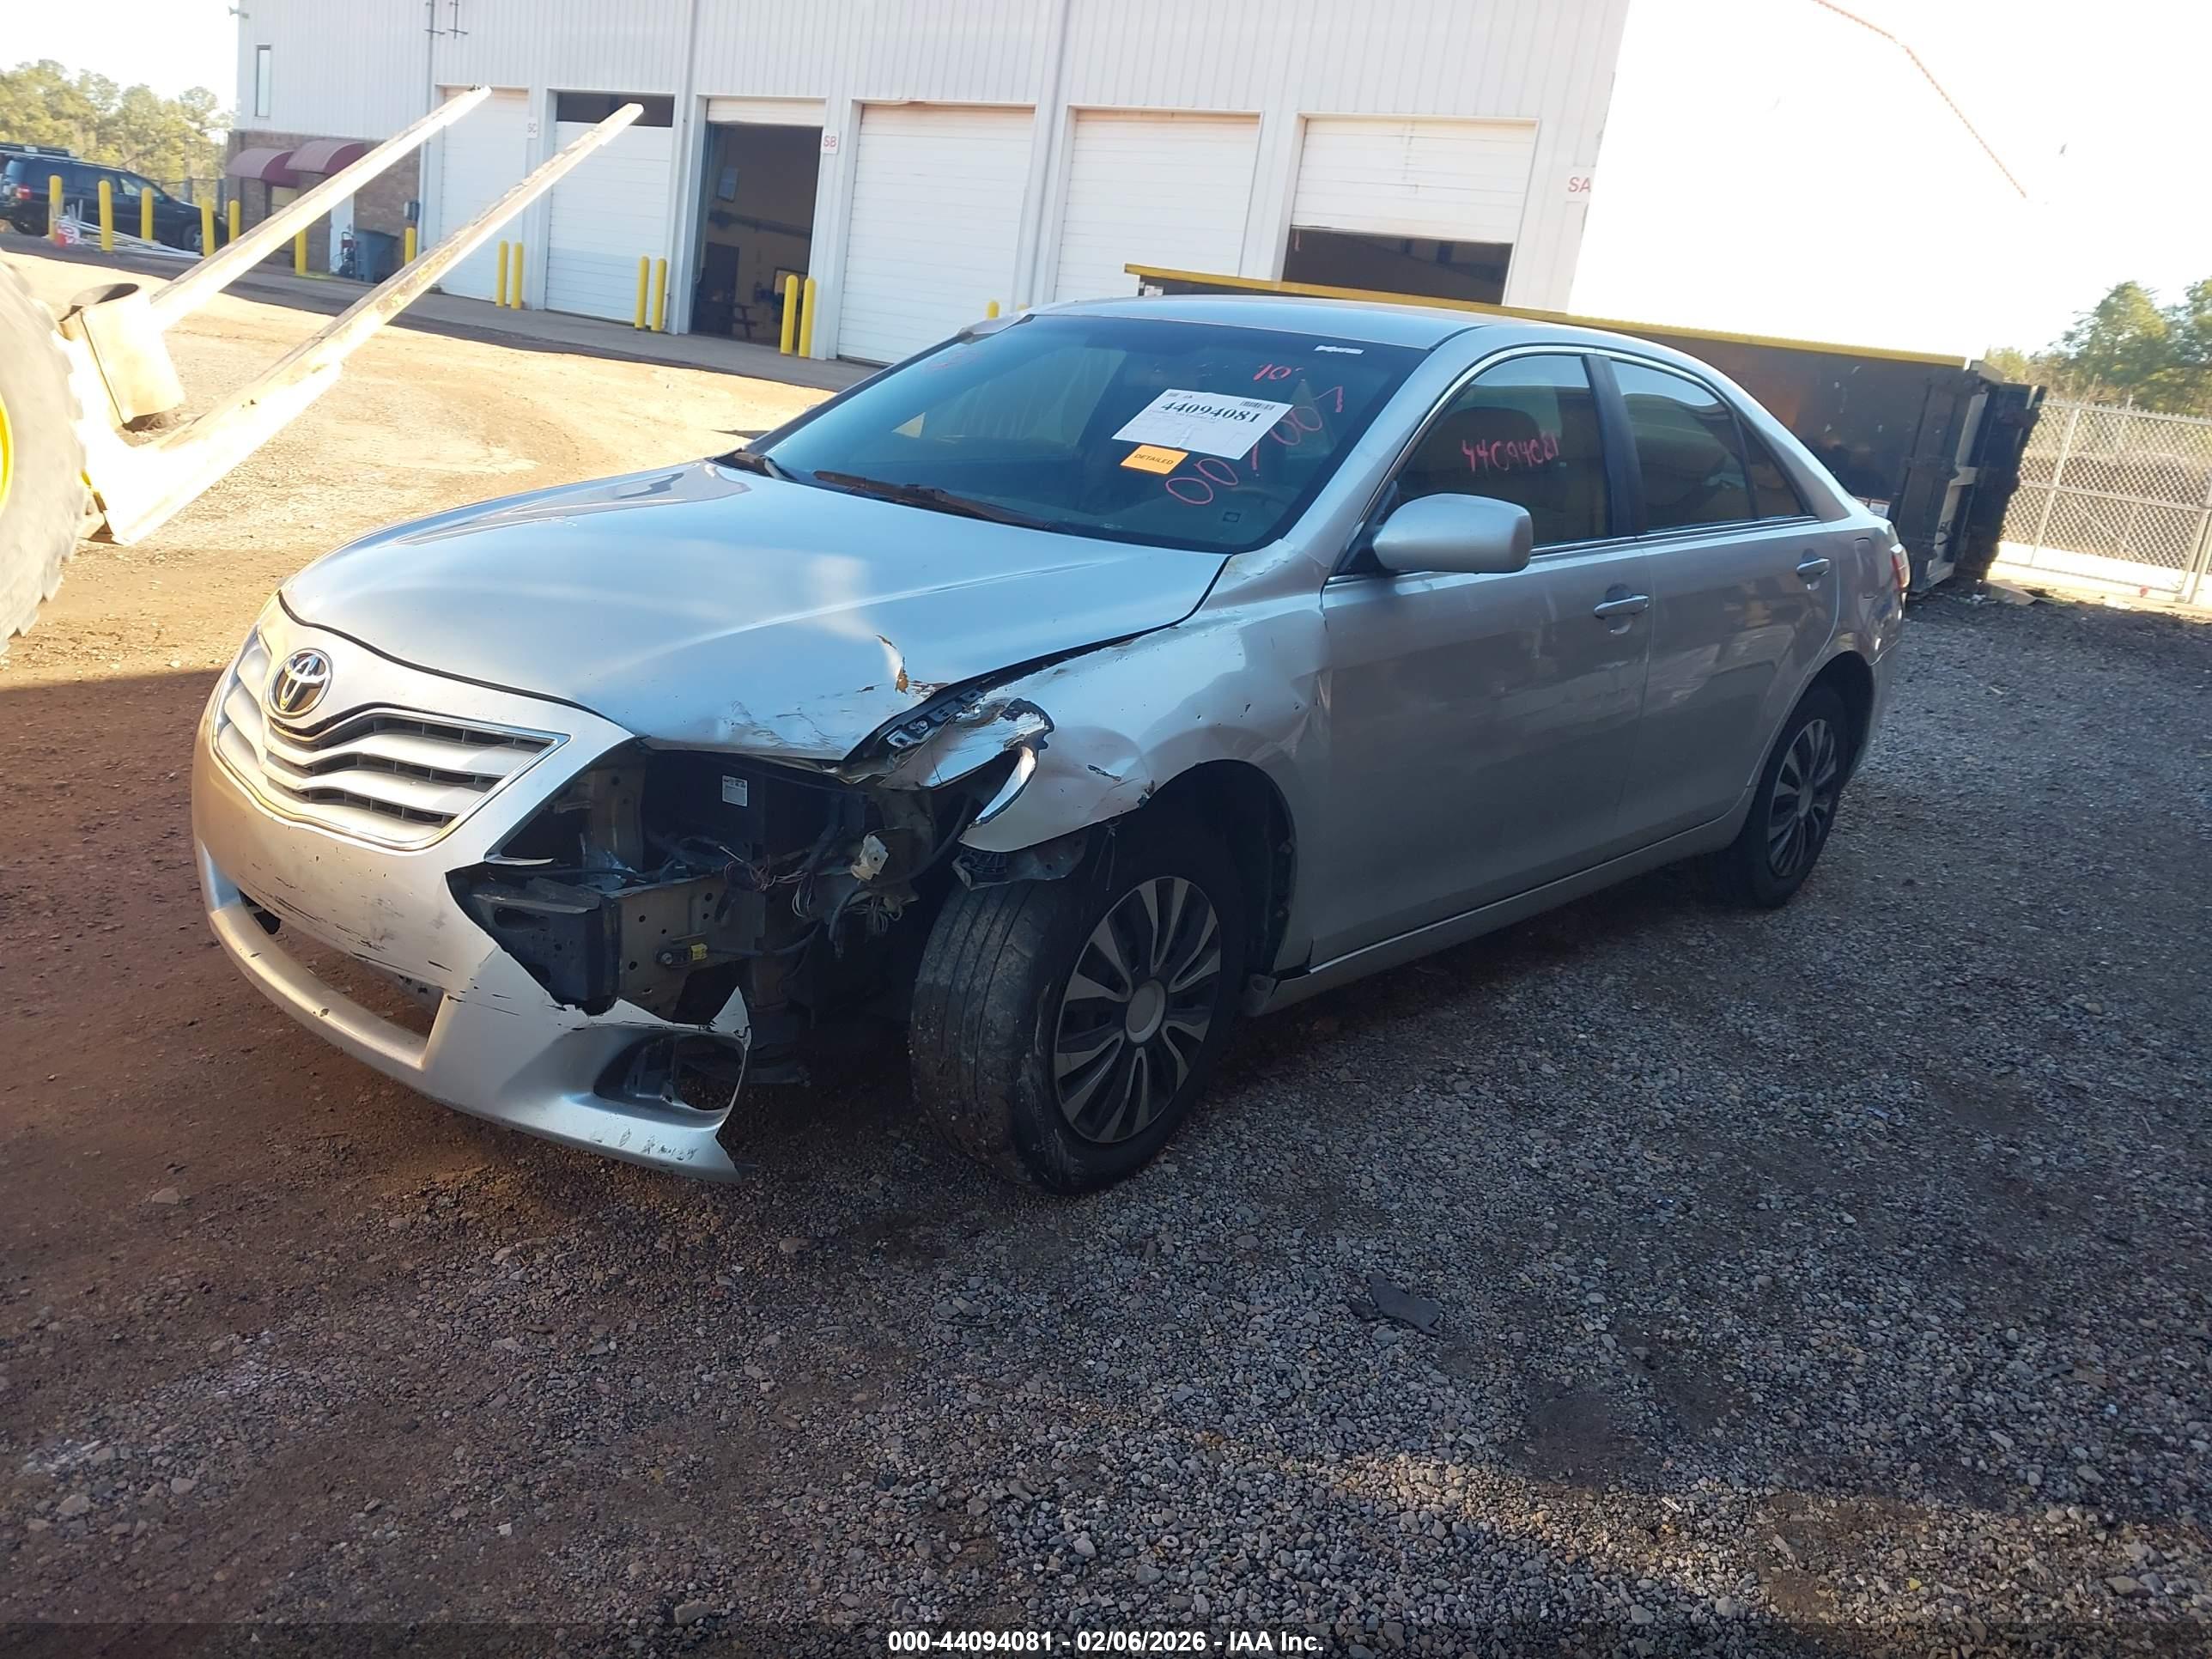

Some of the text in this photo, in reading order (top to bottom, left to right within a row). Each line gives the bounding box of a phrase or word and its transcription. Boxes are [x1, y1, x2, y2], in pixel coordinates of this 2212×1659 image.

[823, 135, 837, 147] SB
[1568, 177, 1591, 193] SA
[1161, 401, 1261, 423] 44094081
[1133, 454, 1174, 465] DETAILED
